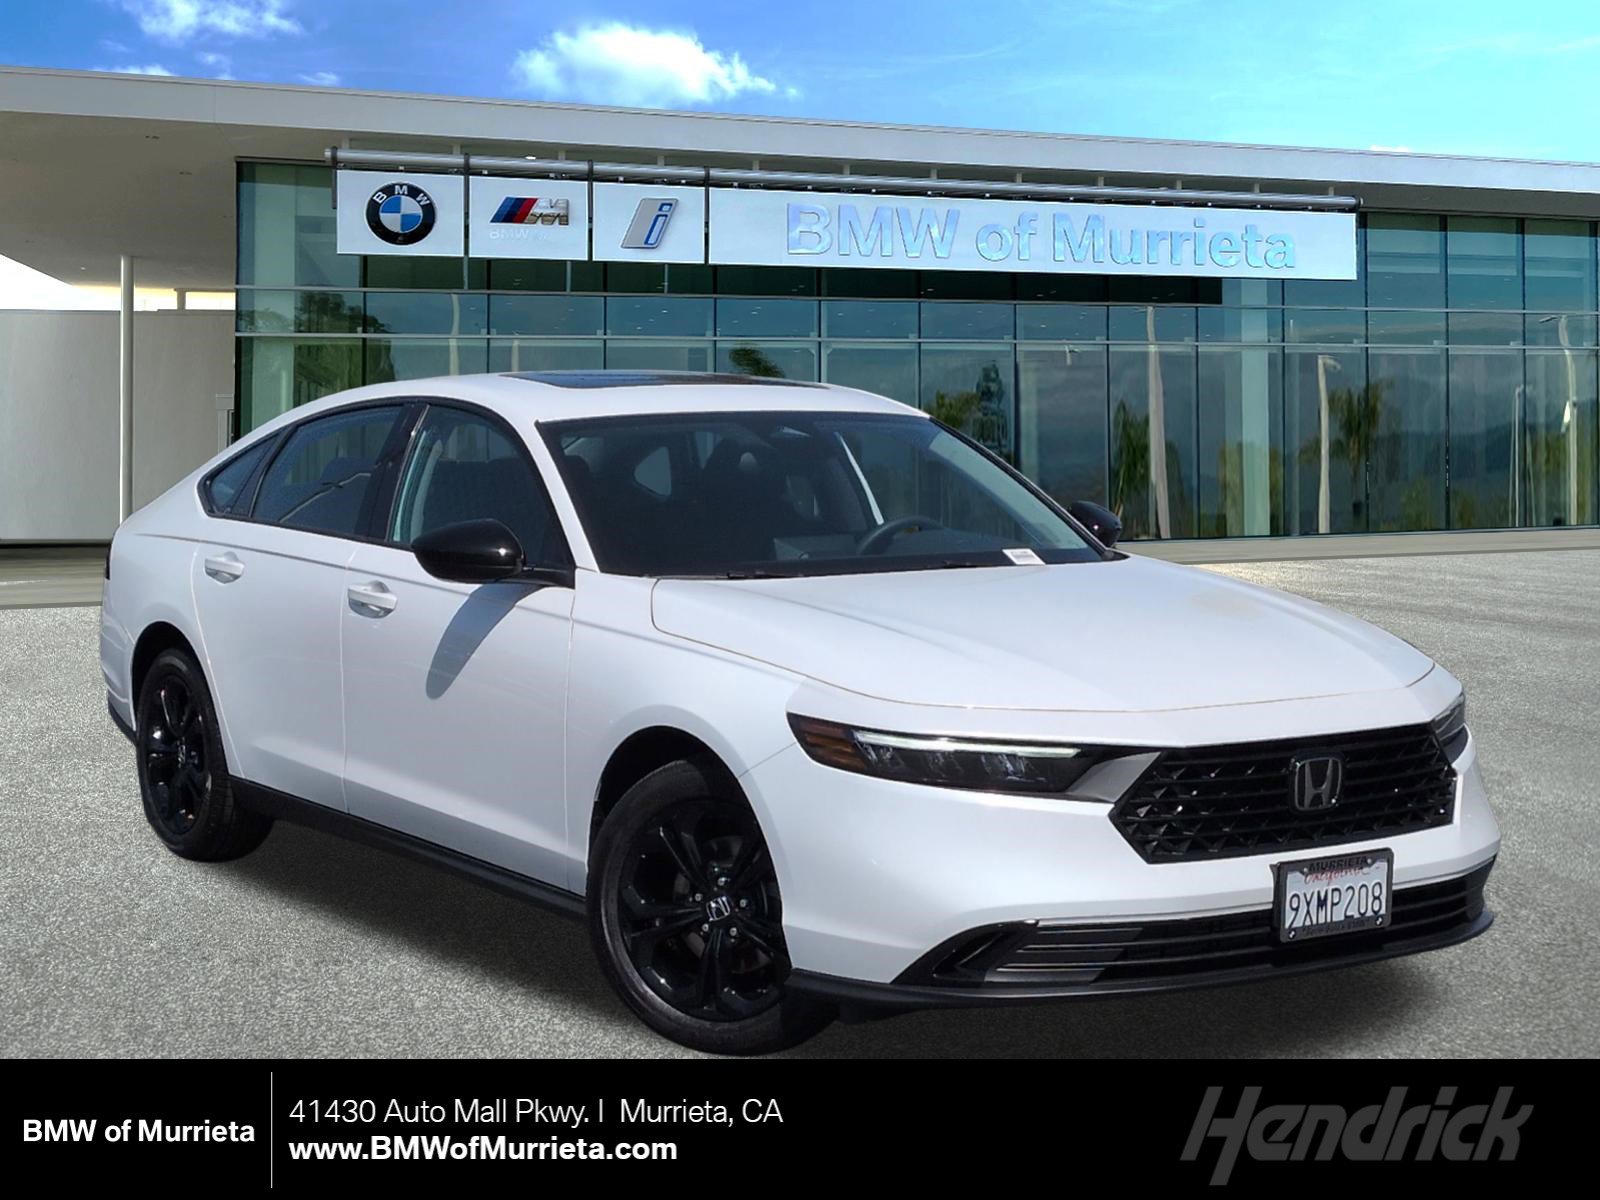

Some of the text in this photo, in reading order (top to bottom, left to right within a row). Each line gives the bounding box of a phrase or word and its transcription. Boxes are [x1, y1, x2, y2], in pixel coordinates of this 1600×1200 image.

[373, 184, 431, 206] BMW
[786, 203, 1297, 269] BMW of Murrieta
[1288, 881, 1383, 929] 9XMP208
